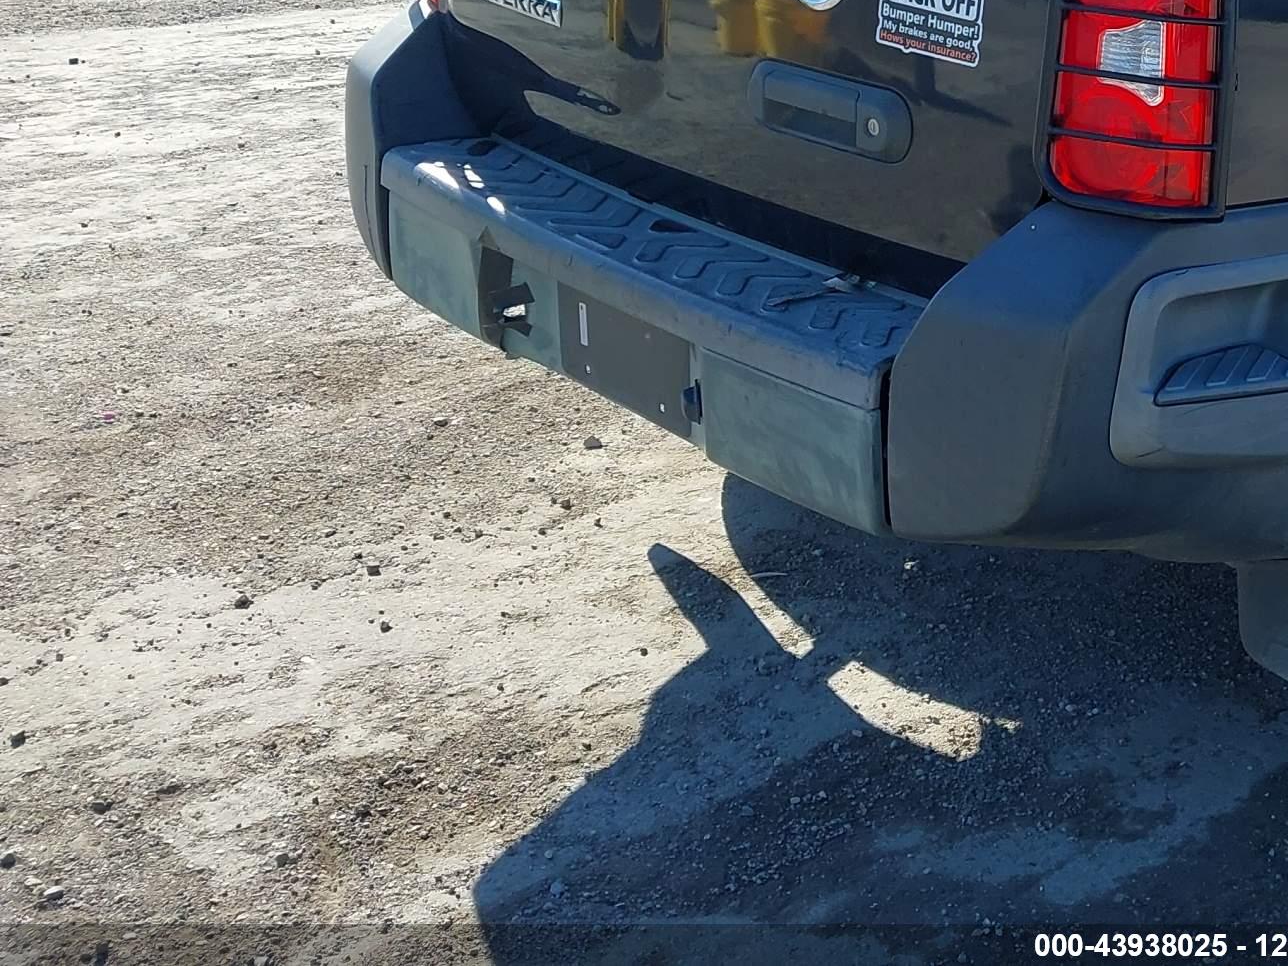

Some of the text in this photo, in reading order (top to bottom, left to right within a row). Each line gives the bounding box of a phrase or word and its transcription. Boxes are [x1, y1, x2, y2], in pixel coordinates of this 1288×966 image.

[882, 2, 979, 39] Bumper Humper!
[883, 19, 974, 52] My brakes are good,
[880, 29, 977, 63] Hows your insurance?
